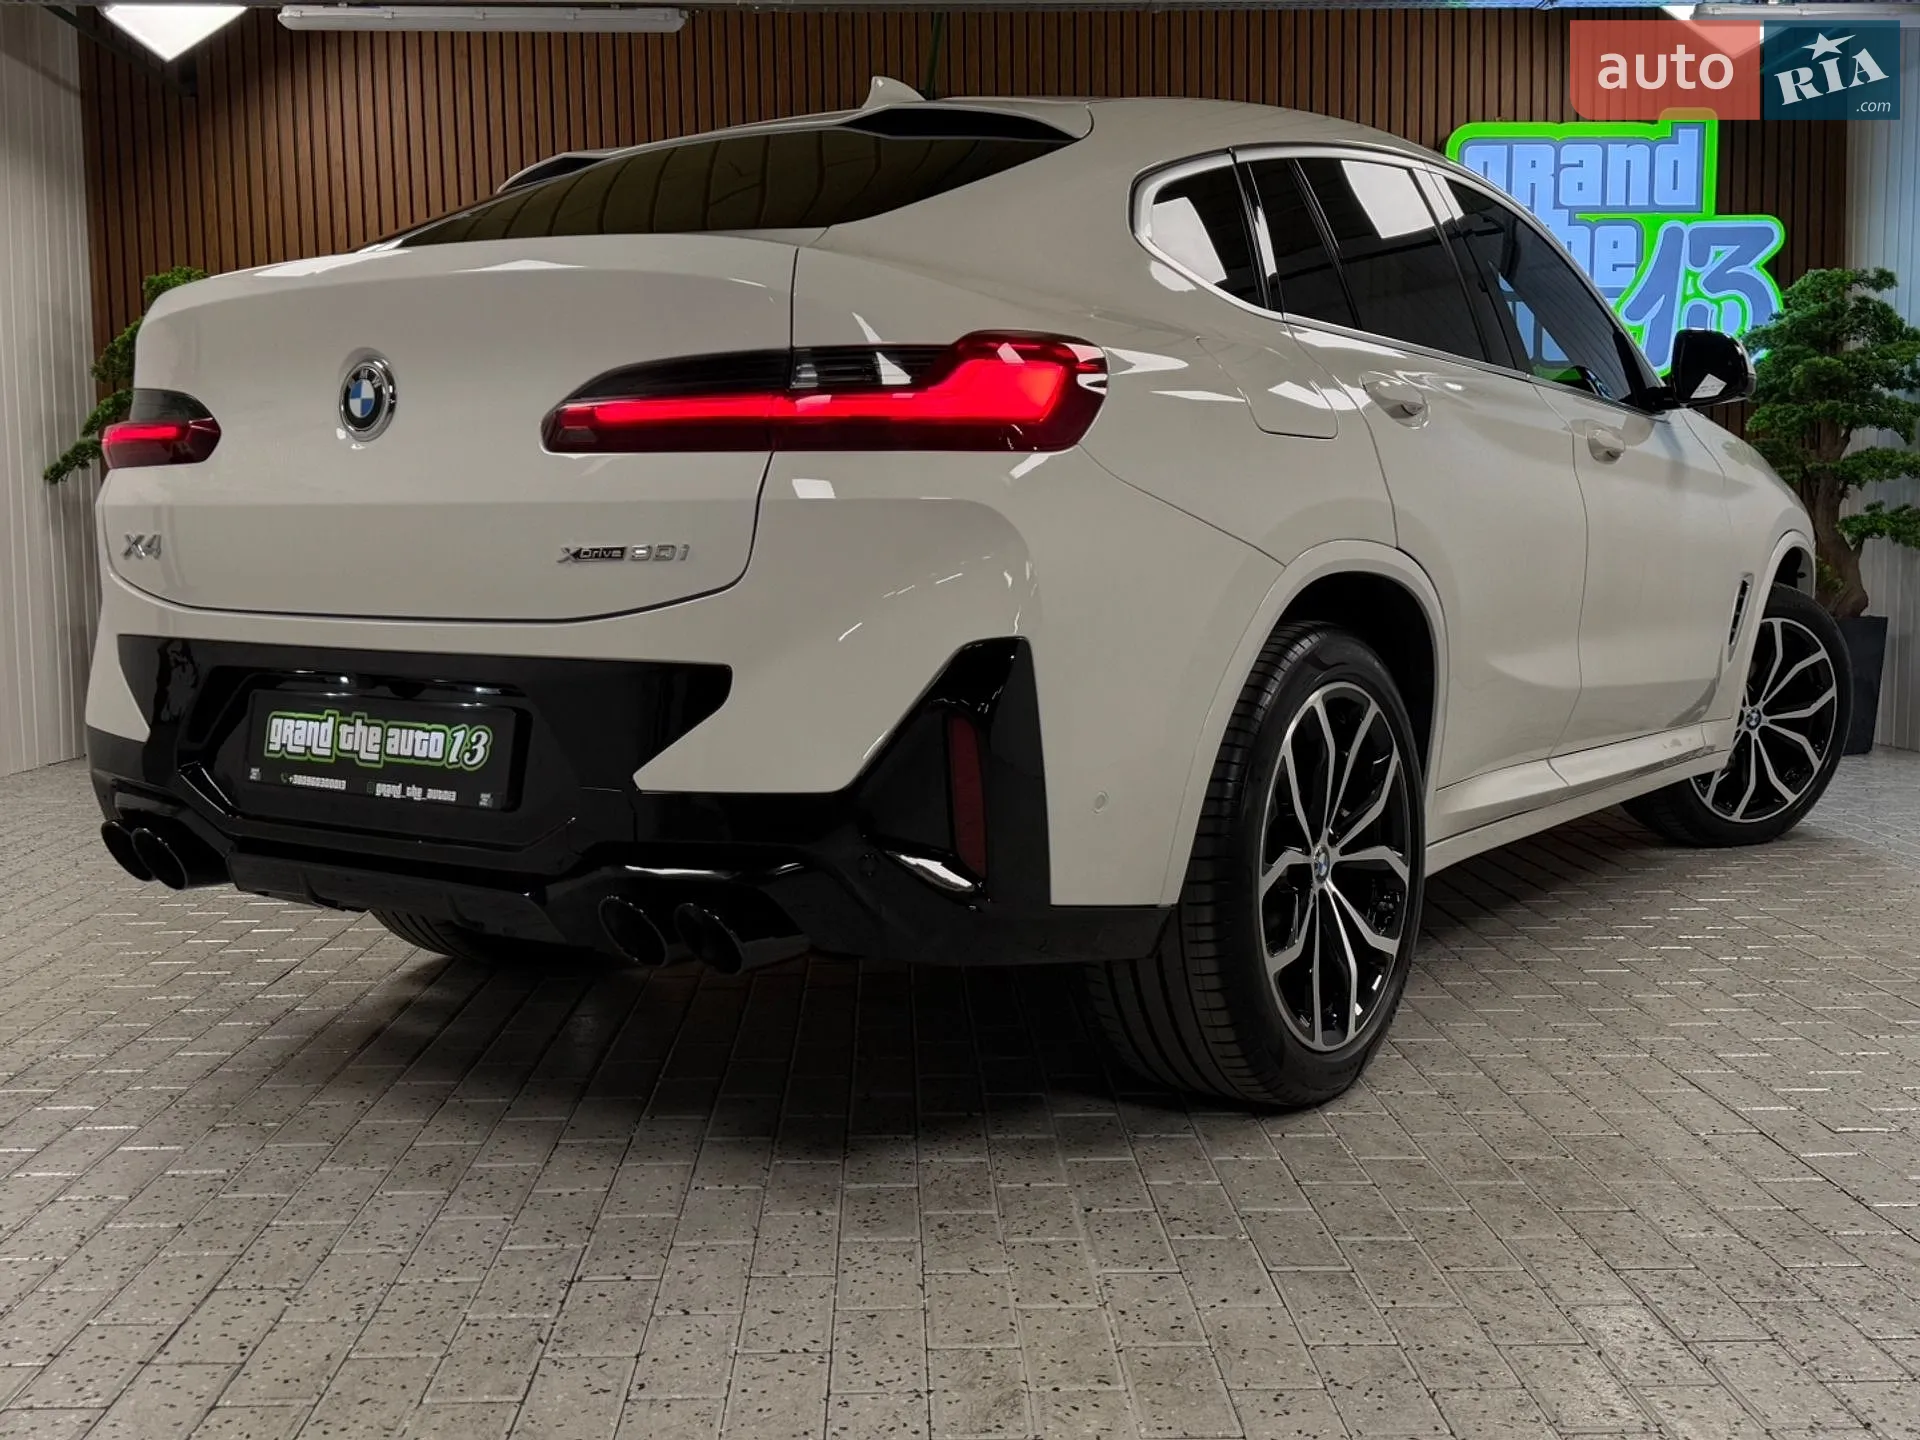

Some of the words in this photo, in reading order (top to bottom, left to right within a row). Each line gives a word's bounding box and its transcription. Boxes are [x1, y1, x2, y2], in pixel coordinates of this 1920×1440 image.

[122, 533, 162, 560] X4
[338, 718, 383, 761] the
[385, 727, 446, 760] auto
[448, 729, 489, 766] 13
